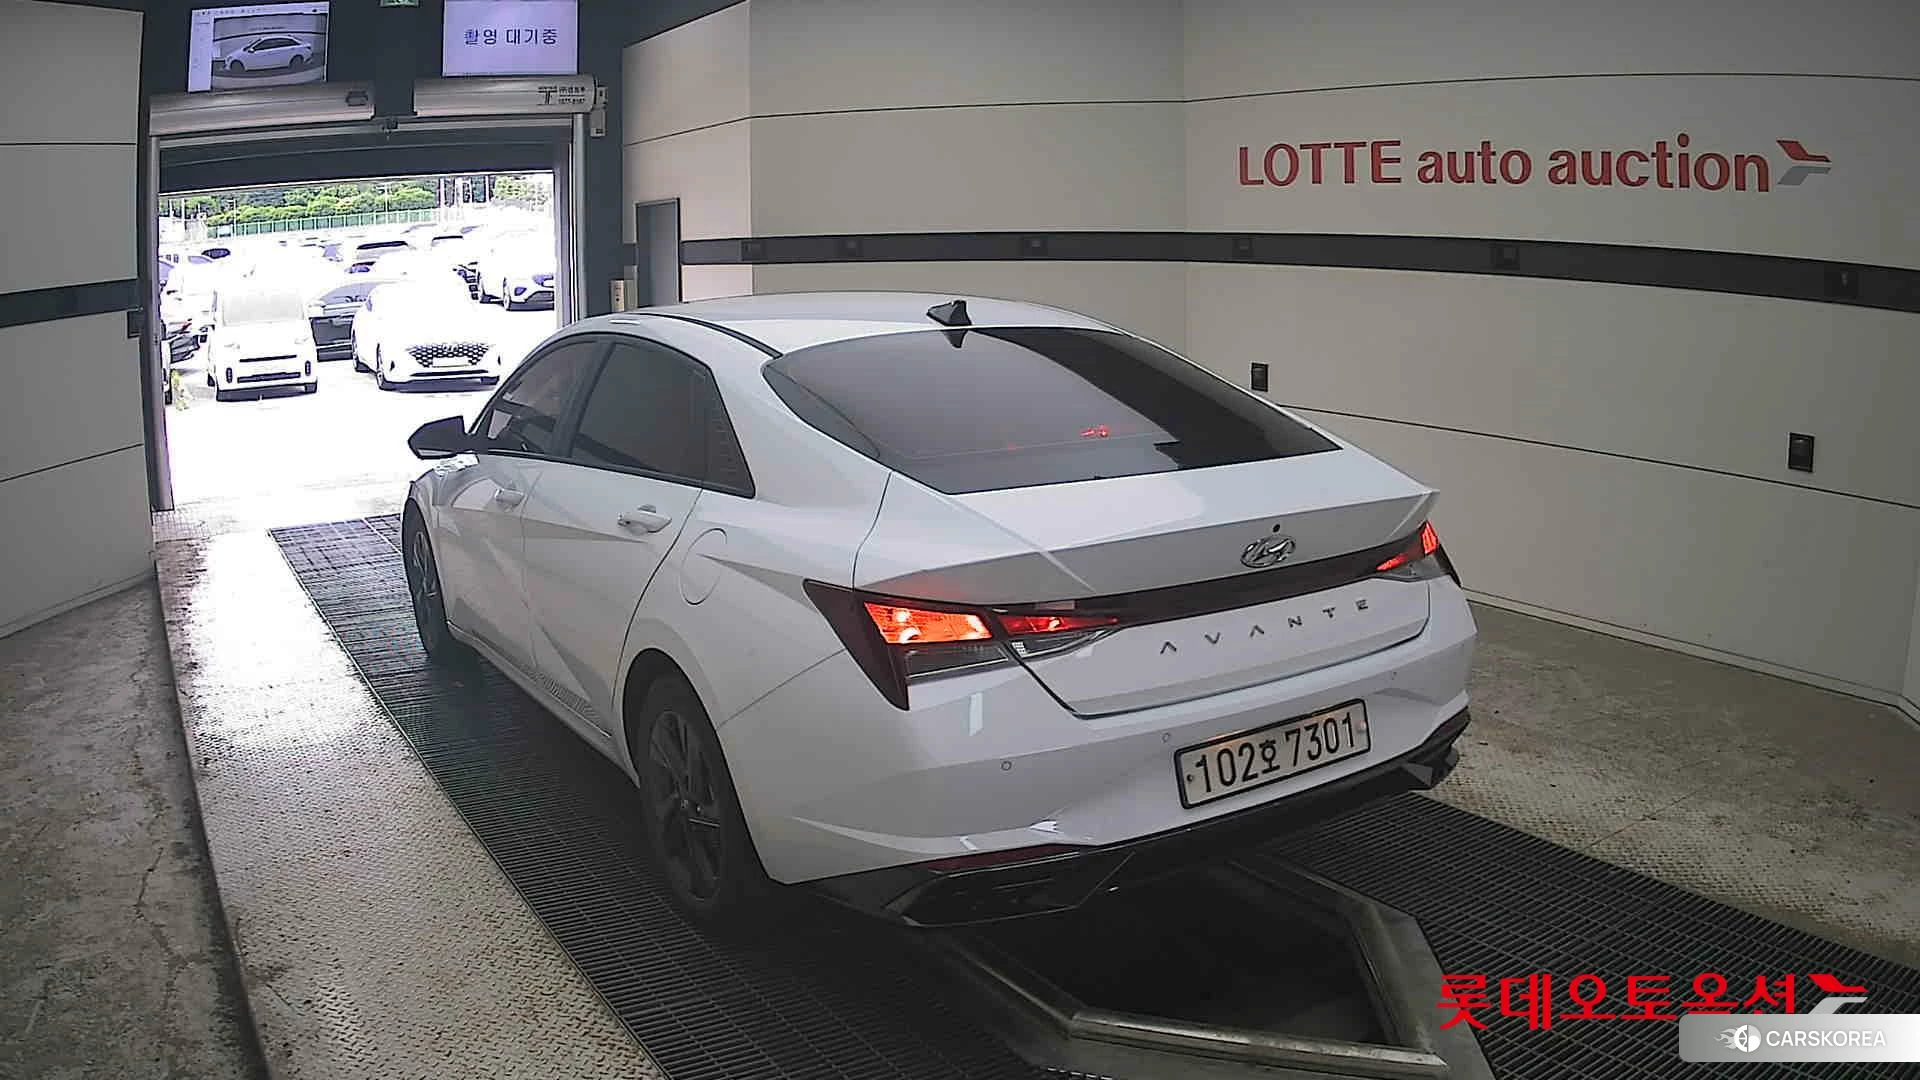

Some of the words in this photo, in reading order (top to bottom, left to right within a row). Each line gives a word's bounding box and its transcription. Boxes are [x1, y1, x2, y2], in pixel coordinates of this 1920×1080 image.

[506, 28, 558, 46] 대기중
[1239, 140, 1402, 187] LOTTE
[1417, 141, 1532, 185] auto
[1548, 133, 1770, 193] auction
[1159, 599, 1370, 655] AVANTE
